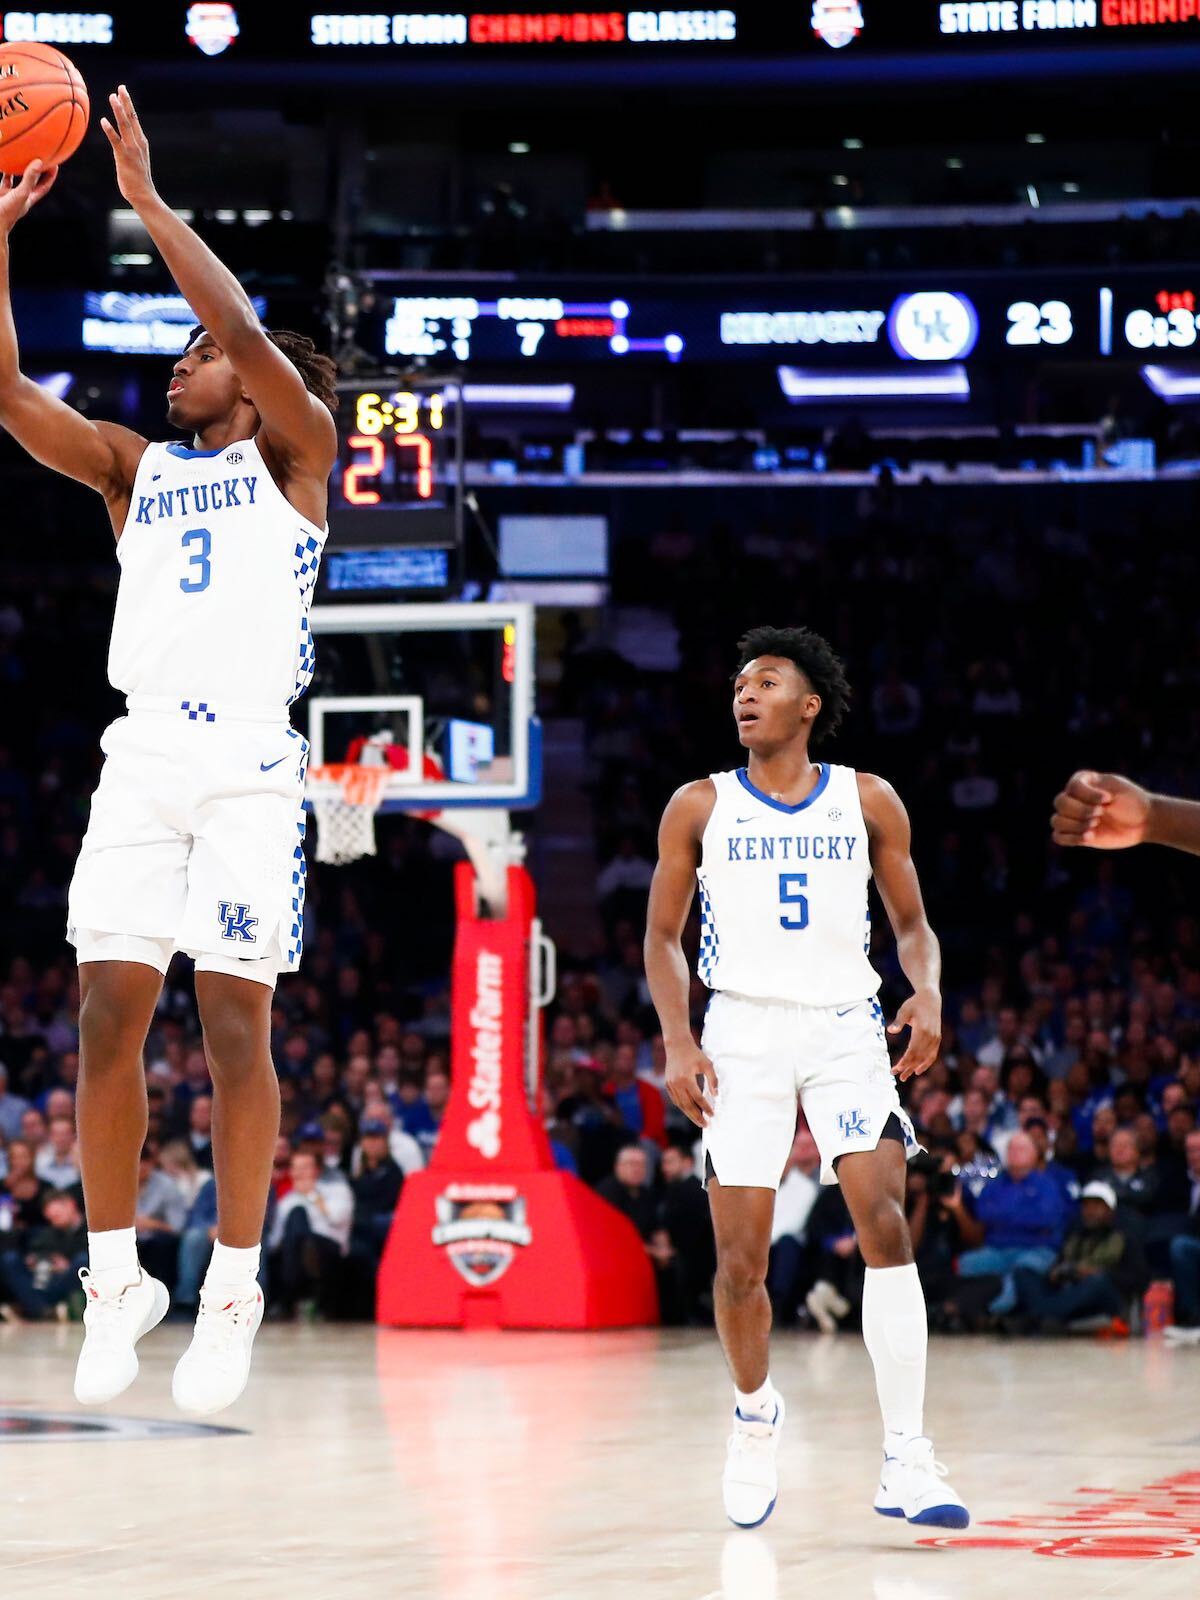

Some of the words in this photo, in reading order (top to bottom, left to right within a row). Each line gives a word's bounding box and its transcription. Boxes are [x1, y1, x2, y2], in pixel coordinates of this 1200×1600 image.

[311, 14, 391, 45] STATE
[392, 14, 467, 45] FARM
[469, 12, 625, 43] CHAMPIONS
[627, 10, 737, 41] CLASSIC
[939, 1, 1019, 34] STATE
[1022, 0, 1097, 30] FARM
[1102, 0, 1200, 26] CHAMP
[516, 322, 545, 357] 7
[720, 311, 885, 345] KENTUCKY
[1006, 300, 1073, 345] 23
[1124, 307, 1200, 349] 6:3
[356, 391, 443, 435] 6:31
[343, 432, 433, 505] 27
[179, 527, 212, 593] 3
[727, 836, 857, 861] KENTUCKY
[218, 901, 258, 943] UK
[778, 872, 810, 931] 5
[837, 1108, 870, 1139] UK
